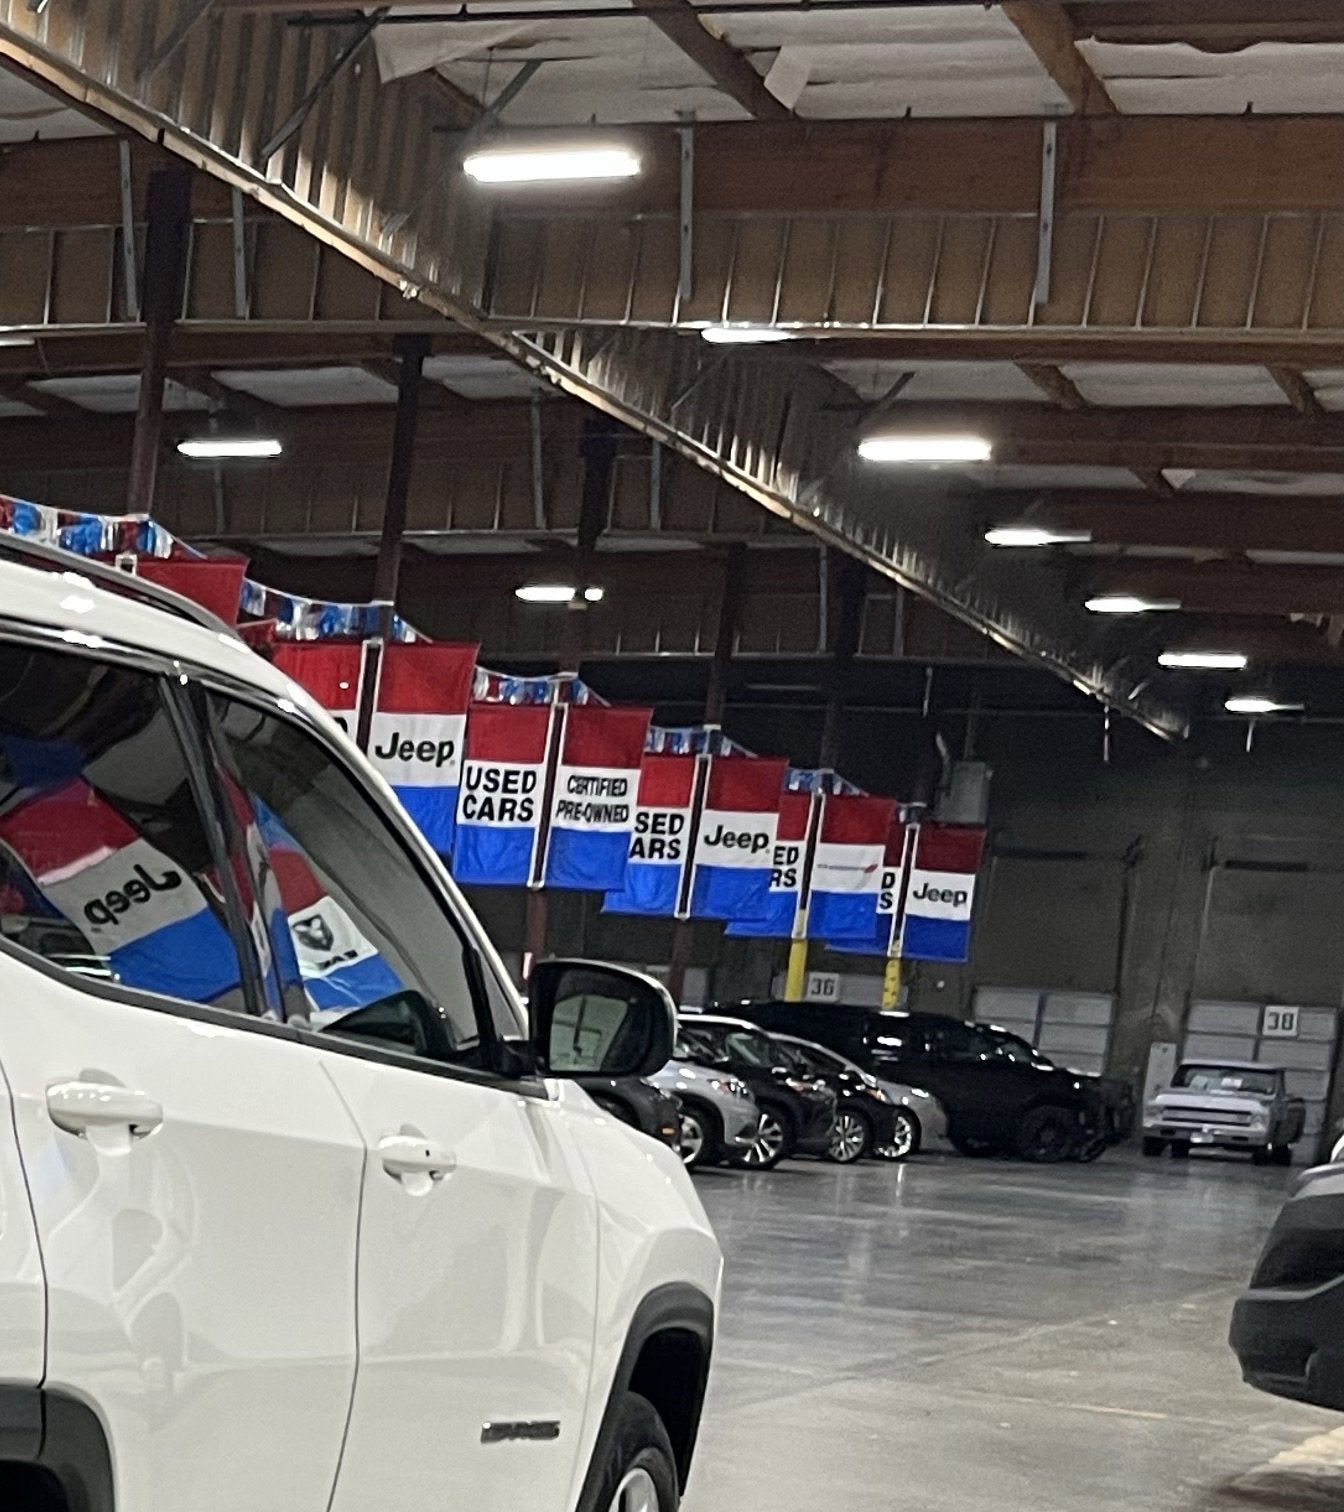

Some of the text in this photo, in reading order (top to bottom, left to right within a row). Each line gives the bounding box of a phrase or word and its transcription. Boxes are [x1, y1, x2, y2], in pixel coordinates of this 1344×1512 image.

[375, 731, 454, 768] Jeep
[466, 766, 537, 794] USED
[567, 775, 628, 797] CERTIFIED
[463, 794, 534, 822] CARS
[555, 799, 630, 823] PRE-OWNED
[634, 811, 684, 836] SED
[629, 837, 681, 860] ARS
[704, 825, 769, 854] Jeep
[913, 882, 968, 908] Jeep
[810, 978, 835, 997] 36
